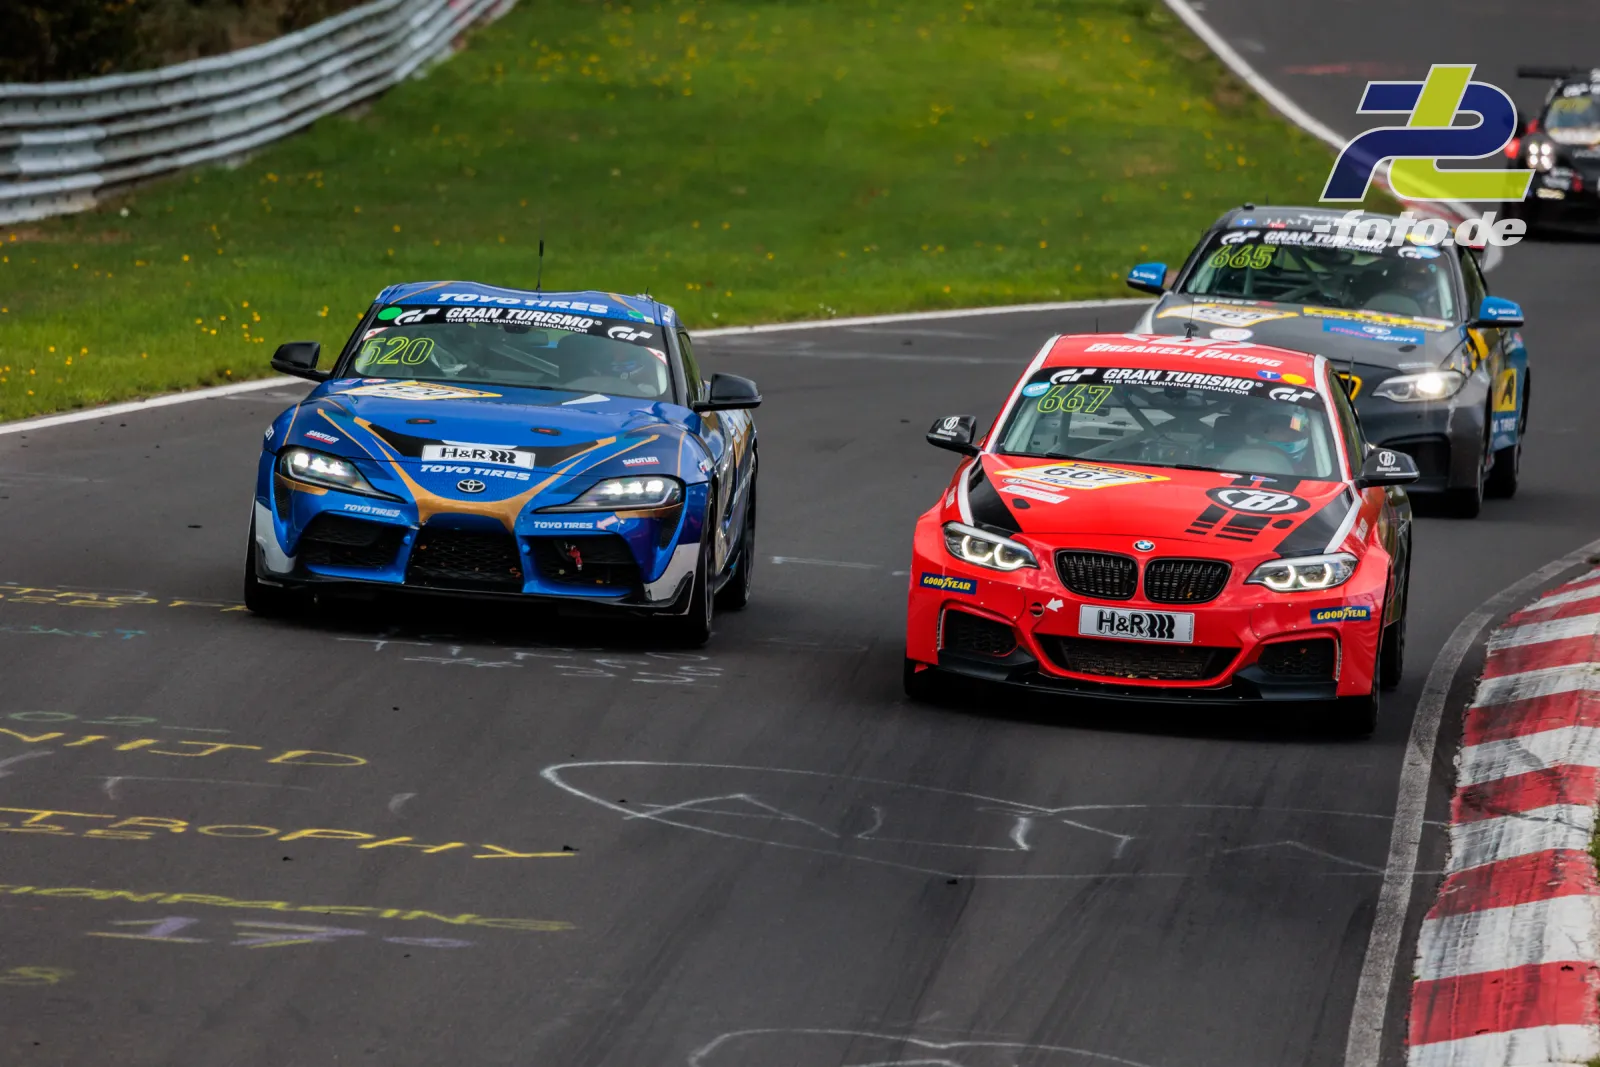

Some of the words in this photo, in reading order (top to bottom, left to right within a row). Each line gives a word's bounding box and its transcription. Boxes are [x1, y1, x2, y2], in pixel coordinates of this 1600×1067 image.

[1263, 230, 1312, 243] GRAN
[1208, 244, 1276, 269] 665
[437, 292, 517, 306] TOYO
[523, 298, 609, 314] TIRES
[445, 307, 504, 320] GRAN
[492, 320, 532, 328] DRIVING
[533, 322, 588, 334] SIMULATOR
[355, 336, 435, 366] 520
[1198, 349, 1285, 367] RACING
[1102, 368, 1160, 382] GRAN
[1151, 380, 1191, 389] DRIVING
[1192, 383, 1249, 395] SIMULATOR
[1036, 384, 1114, 413] 667
[440, 447, 487, 459] H&R
[420, 464, 475, 476] TOYO
[476, 468, 531, 481] TIRES
[1044, 467, 1128, 481] 667
[343, 503, 371, 513] TOYO
[371, 507, 401, 518] TIRES
[534, 521, 562, 529] TOYO
[1097, 609, 1148, 637] H&R
[0, 807, 577, 860] TROPHY
